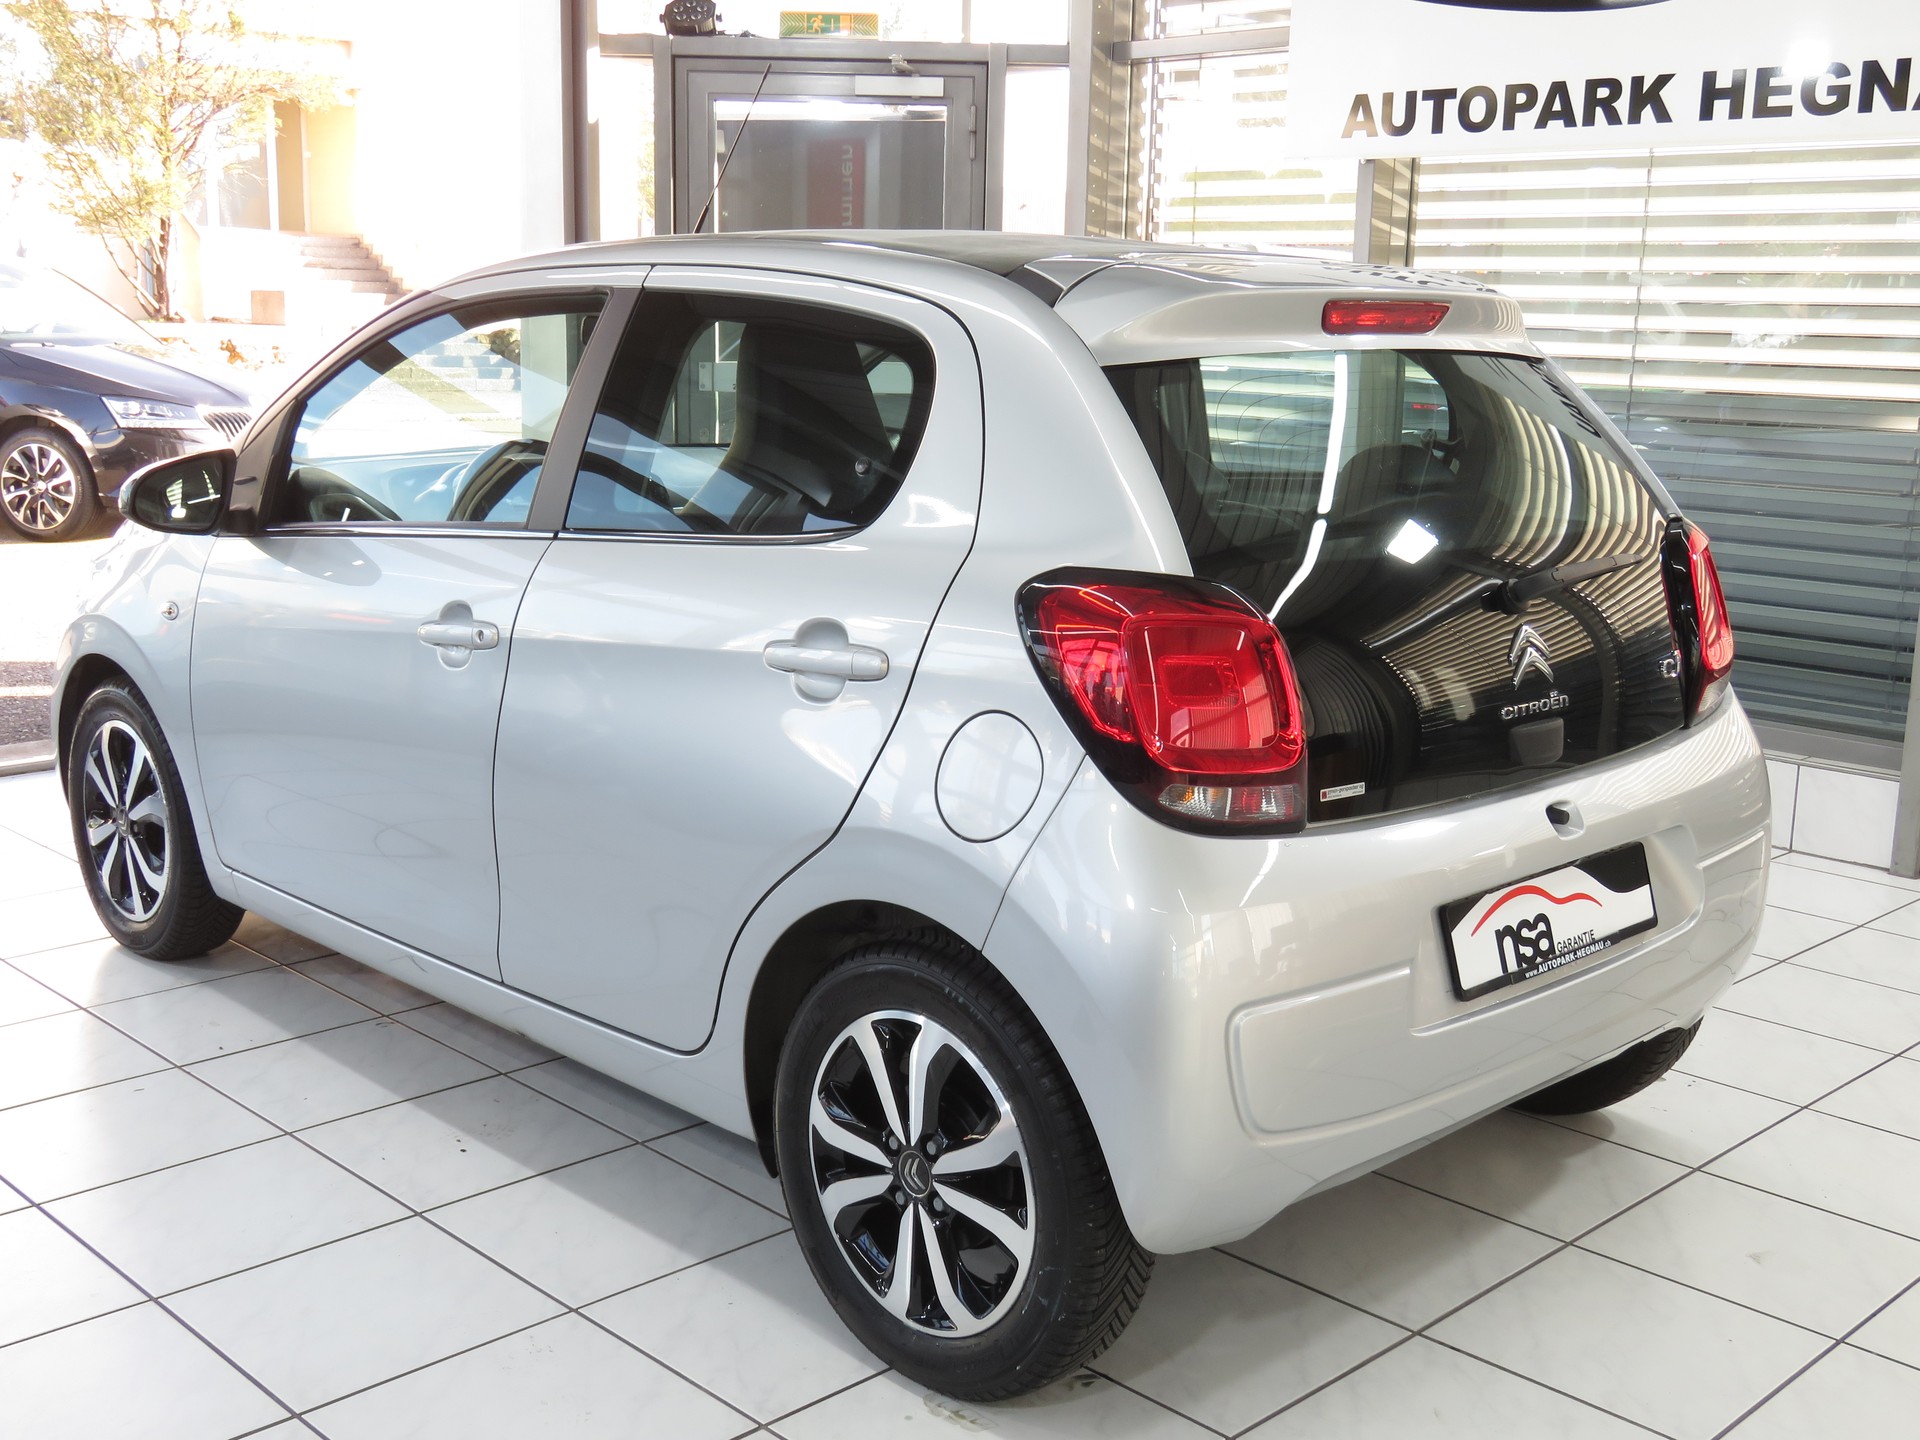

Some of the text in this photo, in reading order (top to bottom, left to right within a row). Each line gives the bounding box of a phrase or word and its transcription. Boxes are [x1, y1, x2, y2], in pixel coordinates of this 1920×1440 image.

[1341, 57, 1920, 139] AUTOPARK HEGN
[1501, 690, 1569, 720] CITROËN
[1494, 912, 1556, 975] nsa
[1524, 939, 1612, 979] www.AUTOPARK-HEGNAU.ch
[1556, 929, 1596, 954] GARANTIE
